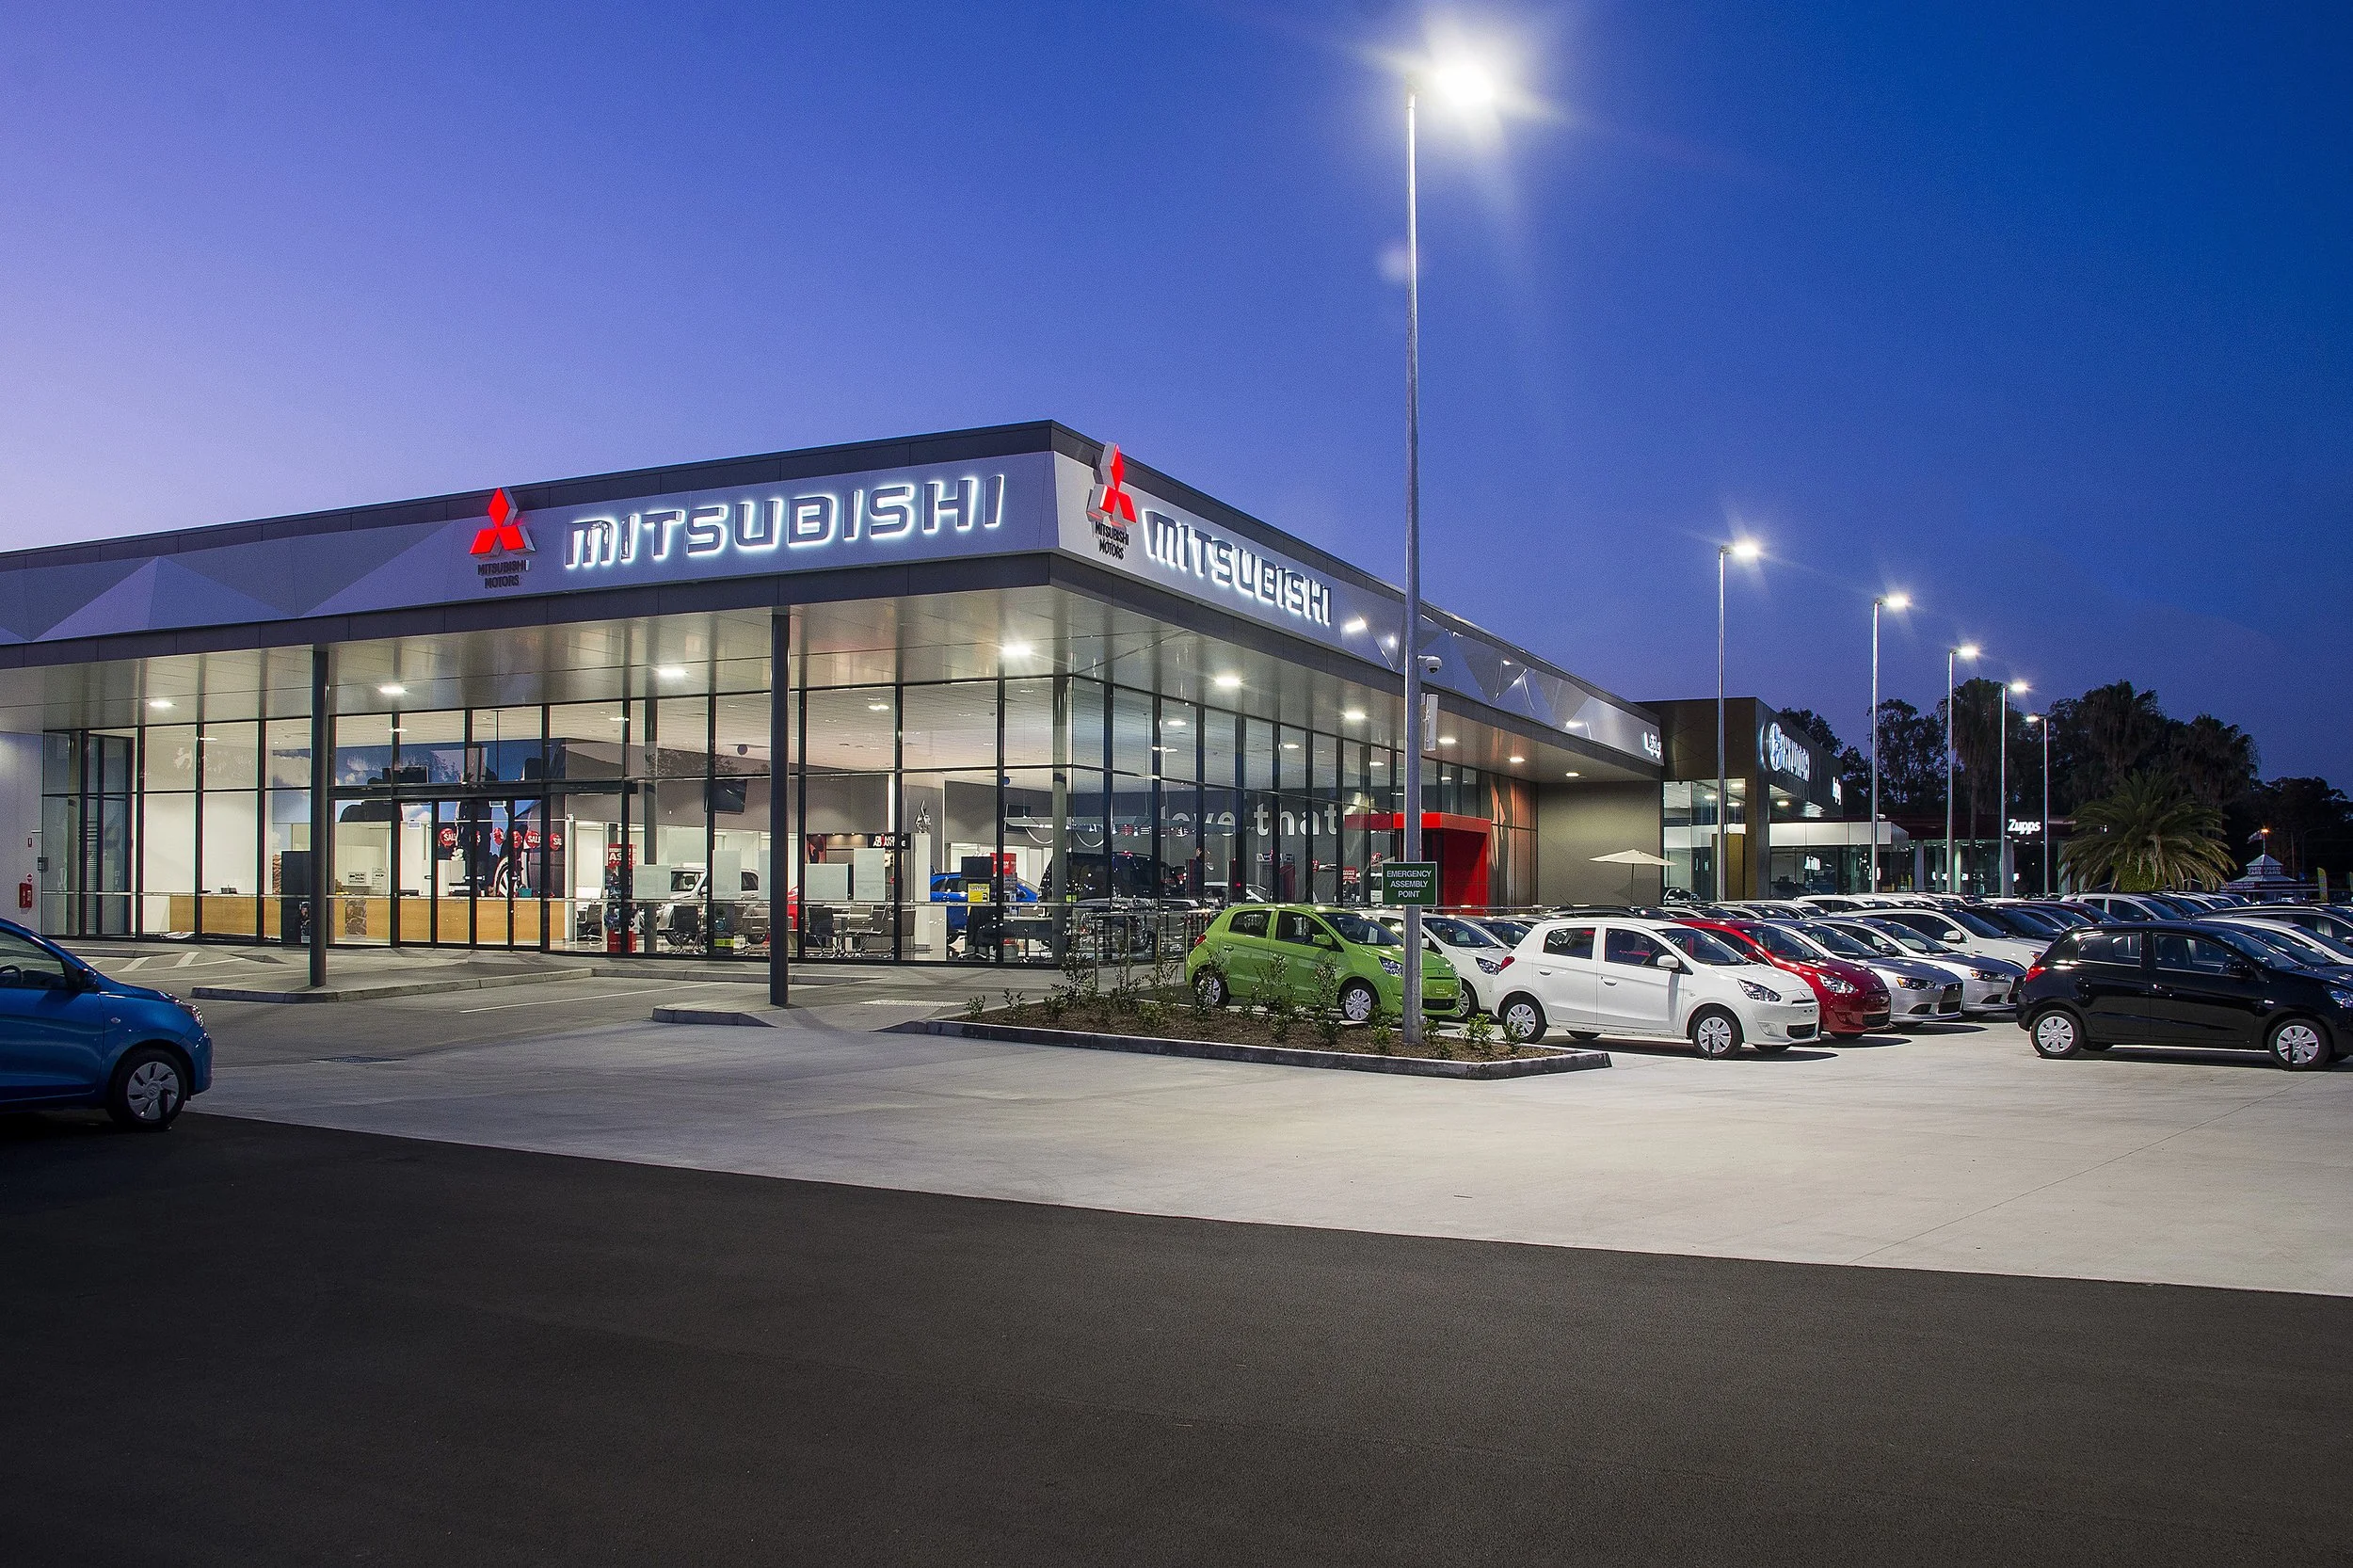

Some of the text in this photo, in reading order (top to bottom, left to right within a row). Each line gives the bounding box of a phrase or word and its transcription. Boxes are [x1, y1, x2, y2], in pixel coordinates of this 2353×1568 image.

[566, 474, 1004, 568] MITSUBISHI
[1096, 521, 1129, 546] MITSUBISHI
[1099, 539, 1124, 560] MOTORS
[477, 560, 529, 575] MITSUBISHI
[1143, 509, 1331, 626] MITSUBISHI
[485, 575, 519, 588] MOTORS
[1253, 802, 1337, 837] that
[2008, 819, 2041, 835] Zupps
[1386, 870, 1432, 878] EMERGENCY
